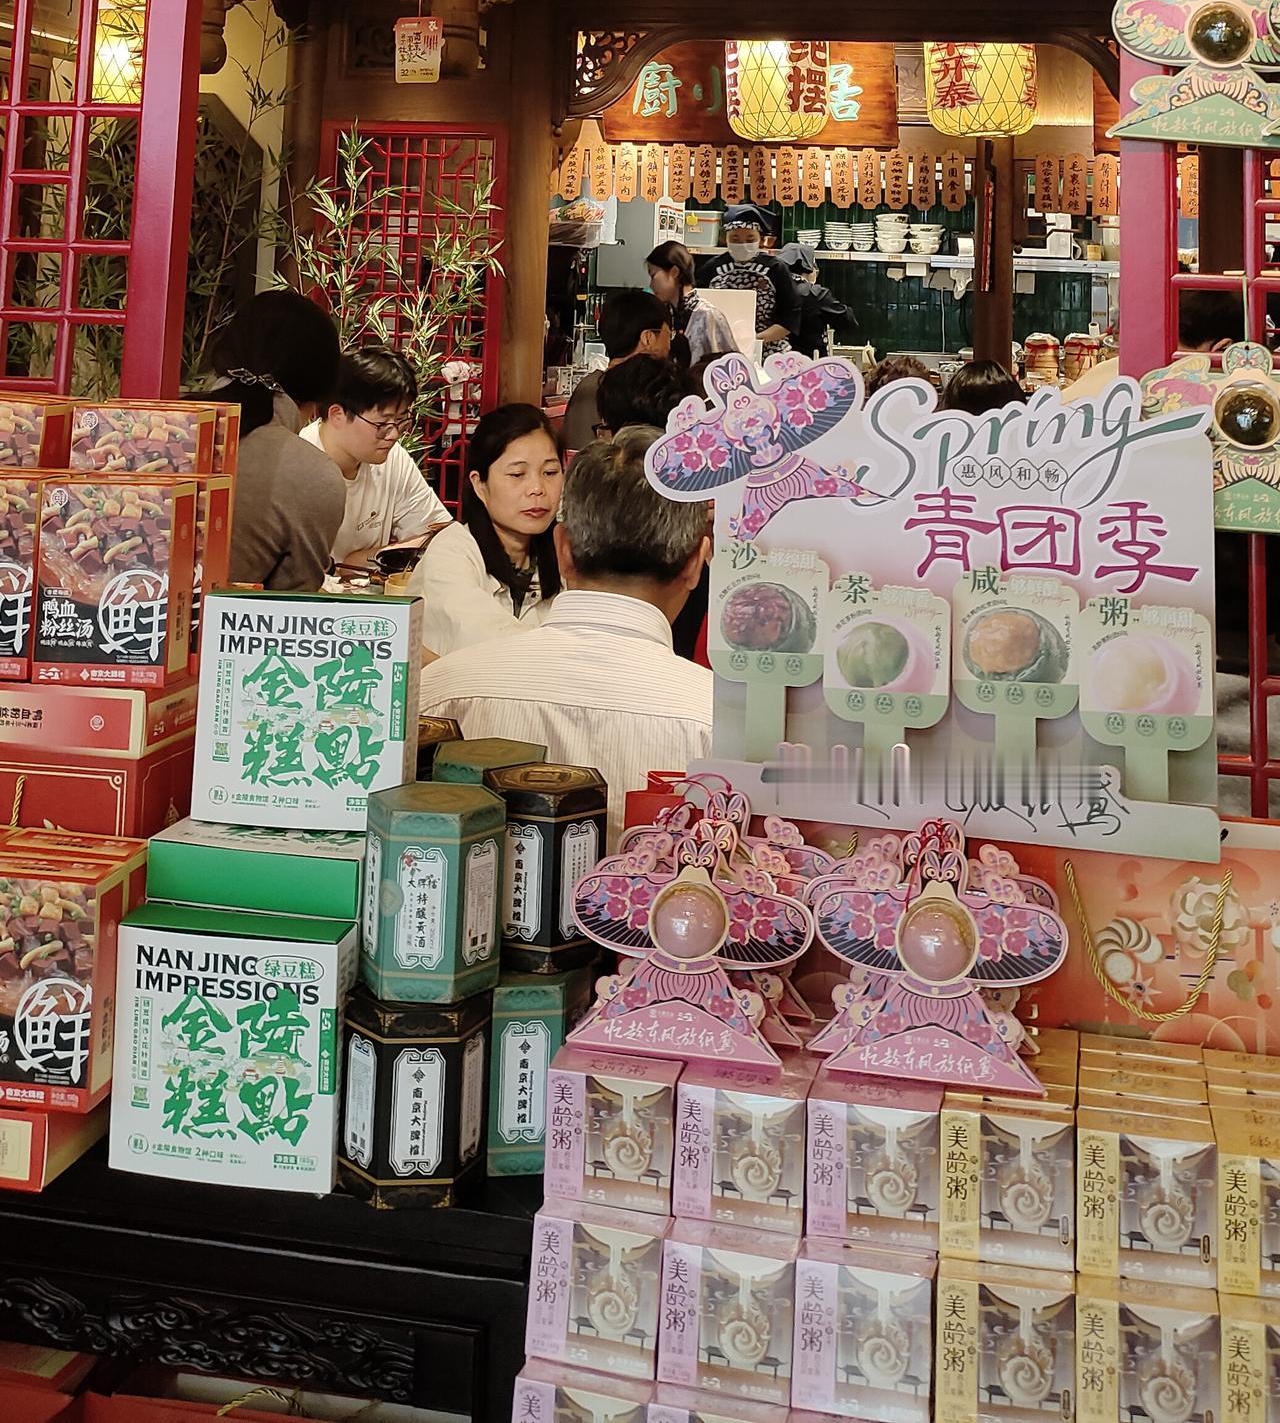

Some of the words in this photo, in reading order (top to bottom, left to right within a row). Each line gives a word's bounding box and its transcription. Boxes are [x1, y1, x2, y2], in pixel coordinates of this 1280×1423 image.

[851, 380, 1207, 508] Spring
[961, 463, 1060, 484] 惠风和畅
[903, 486, 1200, 595] 青团季
[39, 618, 94, 639] 粉丝汤
[42, 598, 79, 619] 鸭血
[98, 571, 170, 663] 鲜
[340, 619, 390, 637] 绿豆糕
[263, 959, 317, 980] 绿豆糕
[15, 983, 93, 1084] 鲜
[552, 1083, 574, 1150] 美龄粥
[680, 1098, 702, 1169] 美龄粥
[812, 1114, 834, 1187] 美龄粥
[946, 1125, 968, 1201] 美龄粥
[1083, 1144, 1105, 1219] 美龄粥
[1225, 1169, 1247, 1242] 美龄粥
[537, 1230, 560, 1304] 美龄粥
[665, 1258, 688, 1333] 美龄粥
[801, 1275, 824, 1353] 美龄粥
[943, 1294, 967, 1373] 美龄粥
[1081, 1313, 1105, 1392] 美龄粥
[1227, 1335, 1251, 1416] 美龄粥
